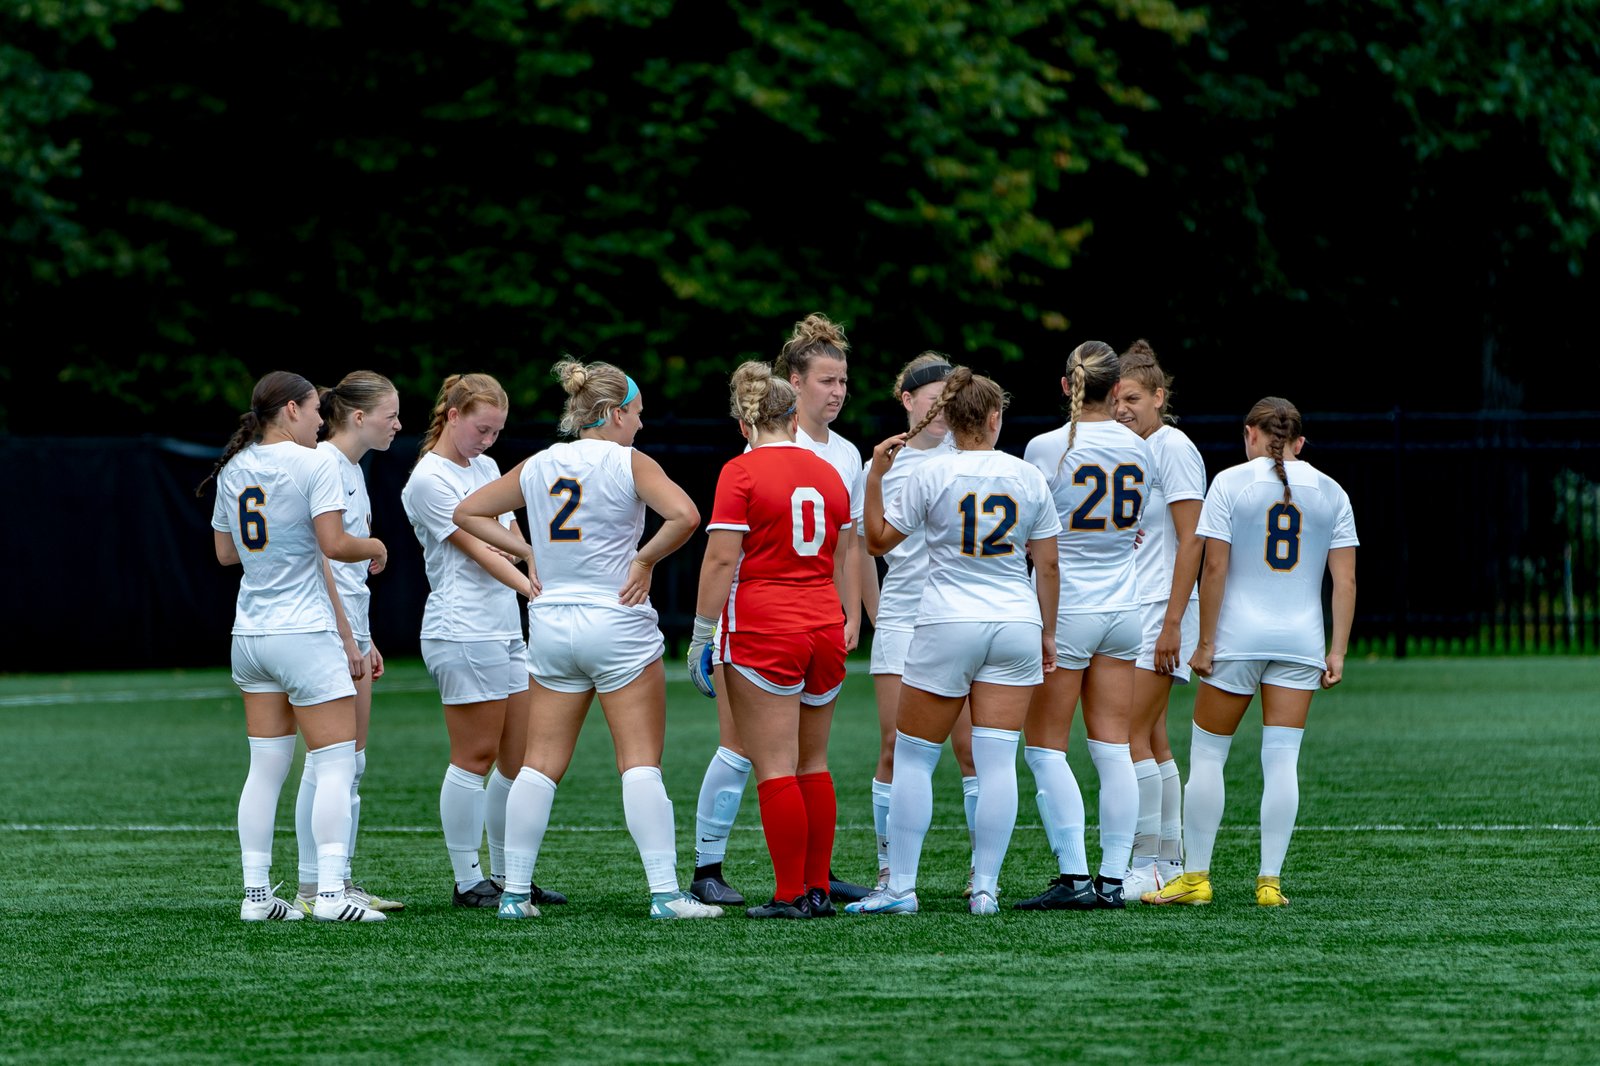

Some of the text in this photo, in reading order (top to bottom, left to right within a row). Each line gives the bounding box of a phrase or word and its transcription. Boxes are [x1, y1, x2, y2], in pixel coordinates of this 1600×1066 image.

[238, 485, 269, 552] 6
[549, 476, 582, 542] 2
[791, 487, 826, 556] 0
[958, 491, 1018, 558] 12
[1069, 462, 1144, 532] 26
[1264, 500, 1303, 572] 8
